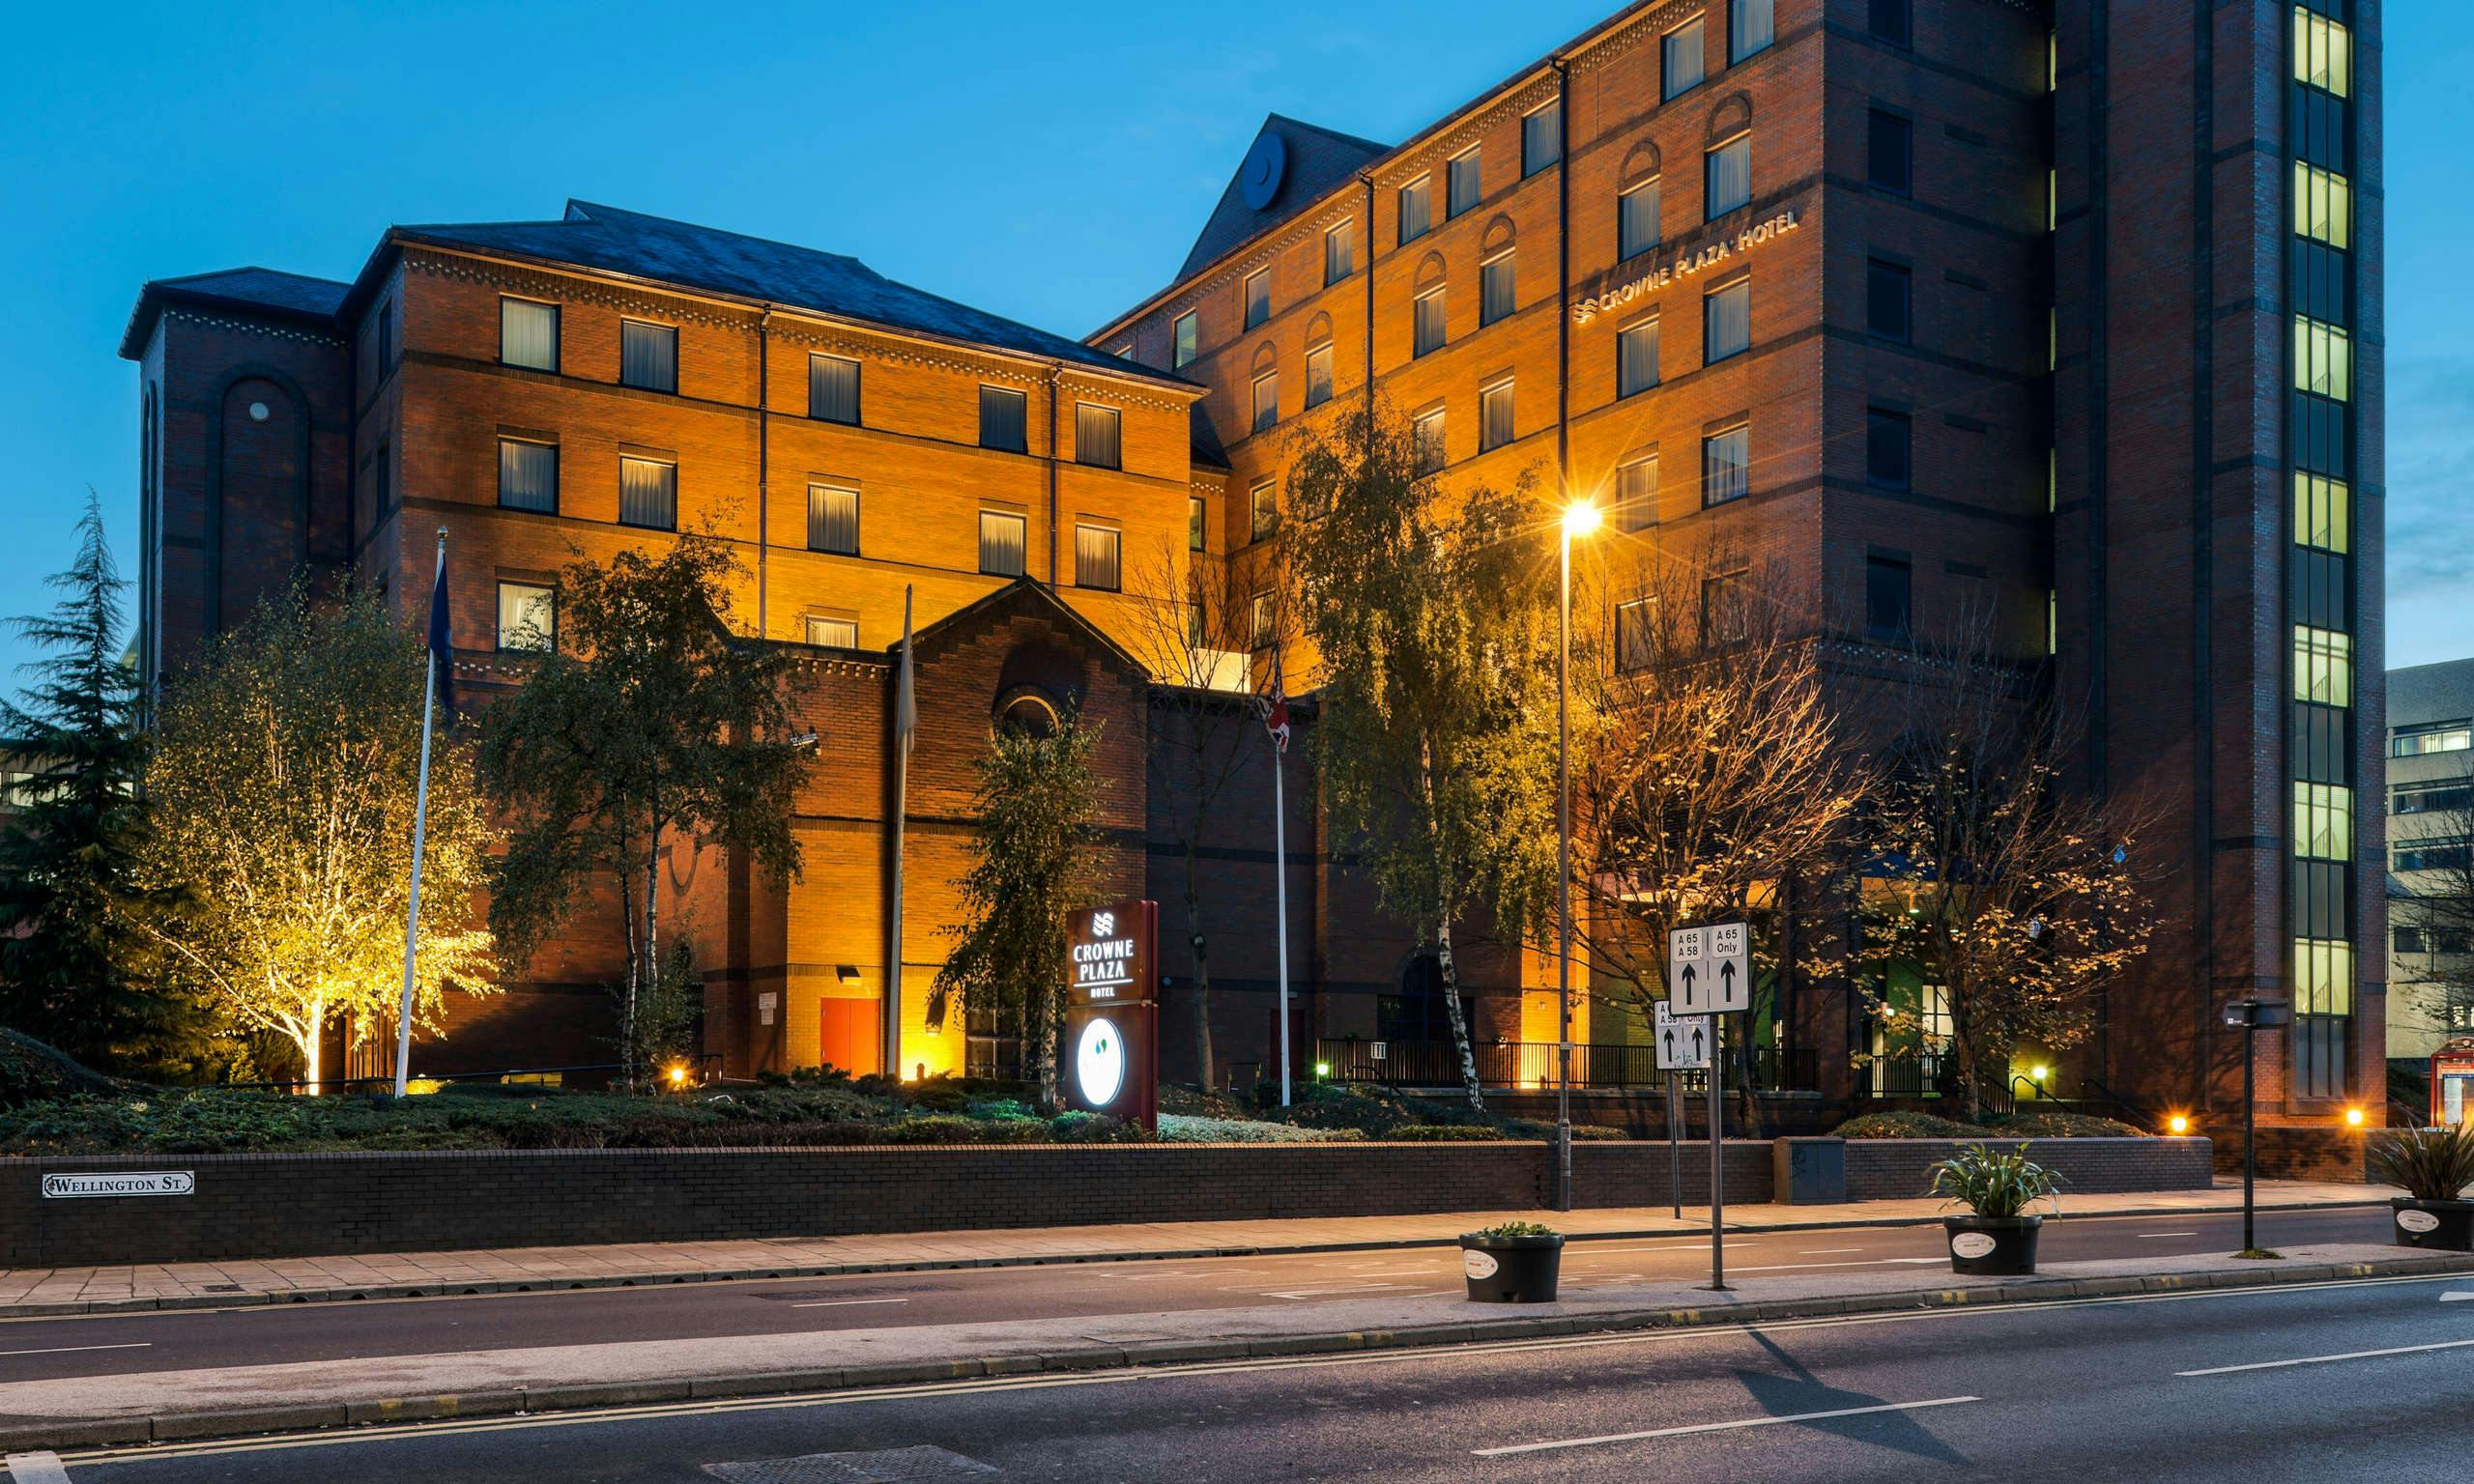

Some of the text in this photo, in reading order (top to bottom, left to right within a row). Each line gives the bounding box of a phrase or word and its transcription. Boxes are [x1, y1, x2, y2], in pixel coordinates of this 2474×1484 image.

[1598, 211, 1798, 311] CROWNE PLAZA HOTEL
[1679, 933, 1698, 945] A 65
[1716, 929, 1738, 940] A 65
[1074, 940, 1134, 961] CROWNE
[1679, 946, 1698, 956] A 58
[1717, 942, 1738, 954] Only
[1080, 960, 1125, 981] PLAZA
[1090, 987, 1115, 998] HOTEL
